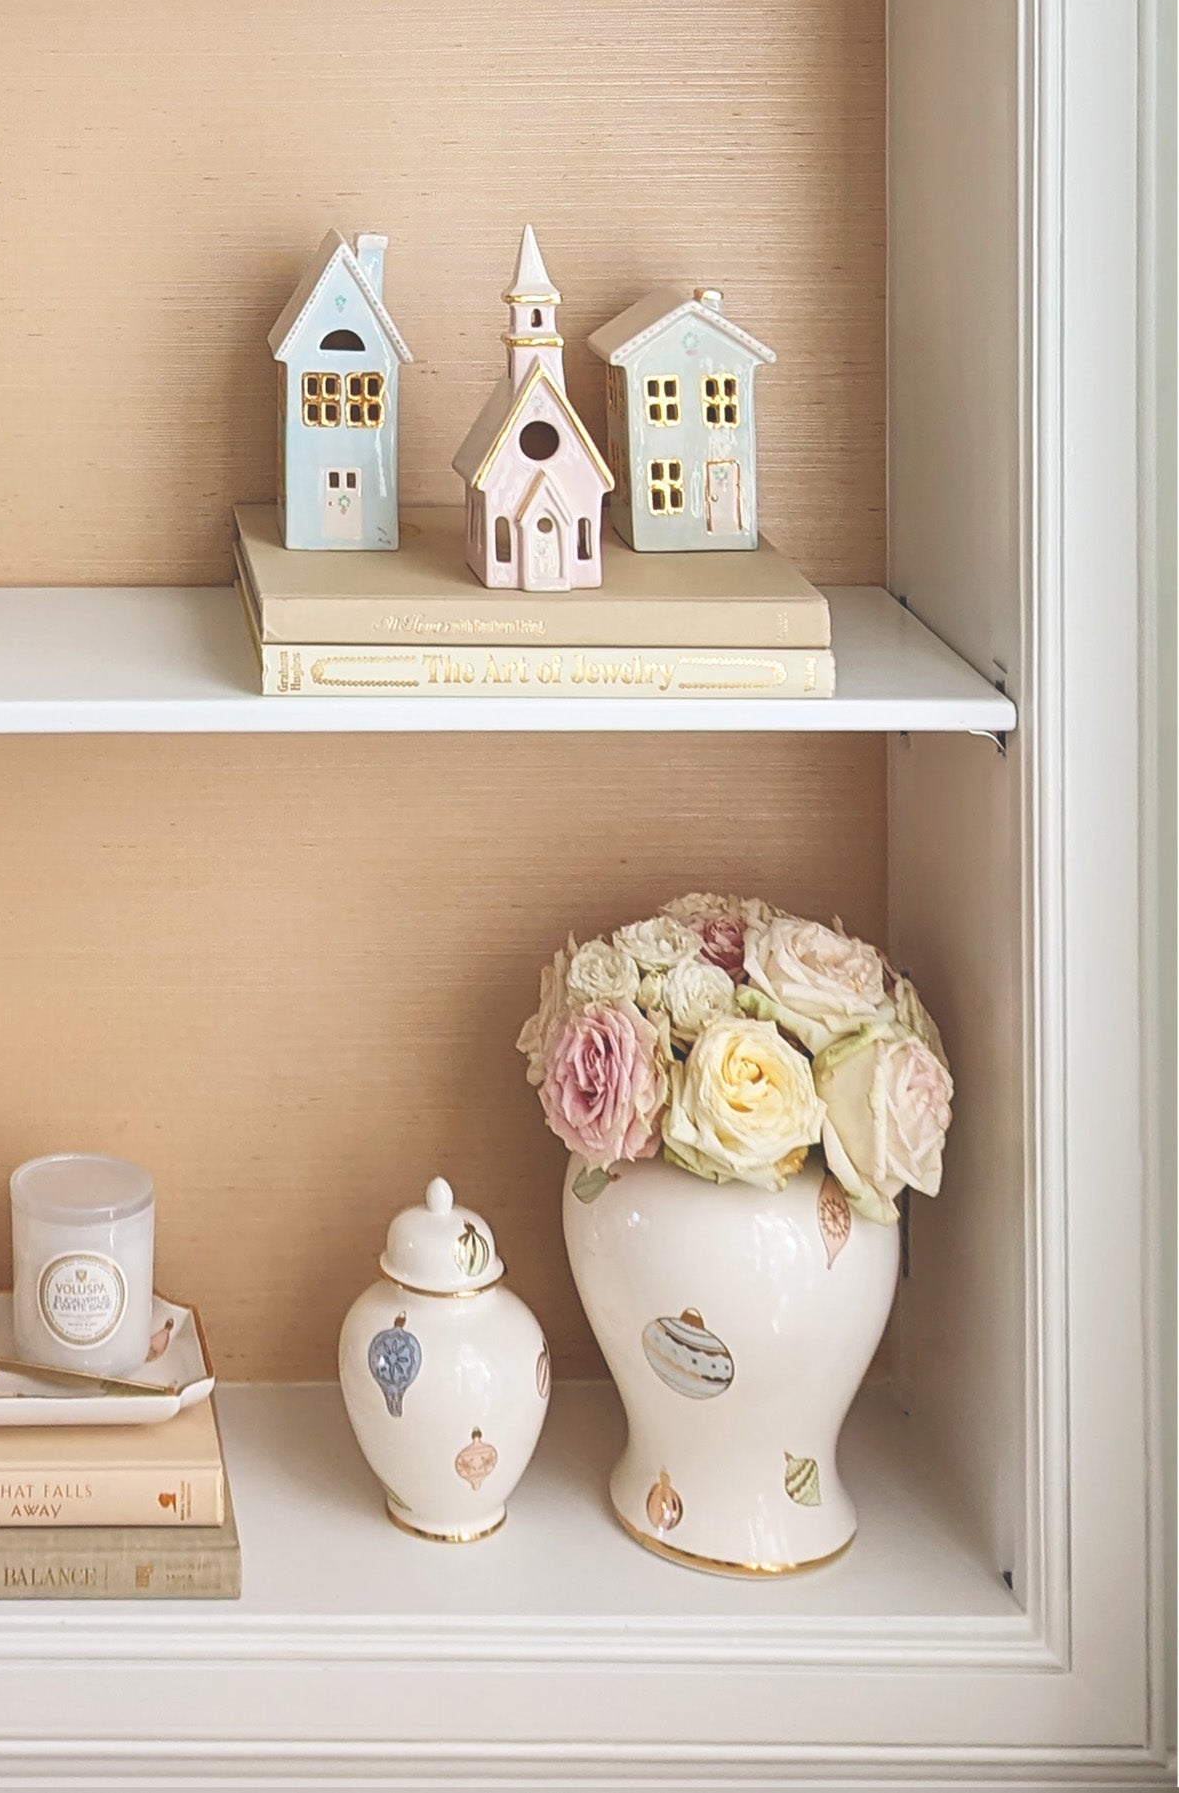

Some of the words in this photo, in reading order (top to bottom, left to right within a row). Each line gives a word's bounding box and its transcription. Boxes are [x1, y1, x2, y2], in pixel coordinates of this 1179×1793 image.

[423, 654, 475, 683] The
[481, 655, 530, 684] Art
[535, 655, 563, 684] of
[571, 654, 676, 691] Jewelry
[55, 1283, 107, 1295] VOLUSPA
[44, 1484, 93, 1499] FALLS
[10, 1505, 62, 1518] AWAY
[4, 1567, 98, 1587] BALANCE
